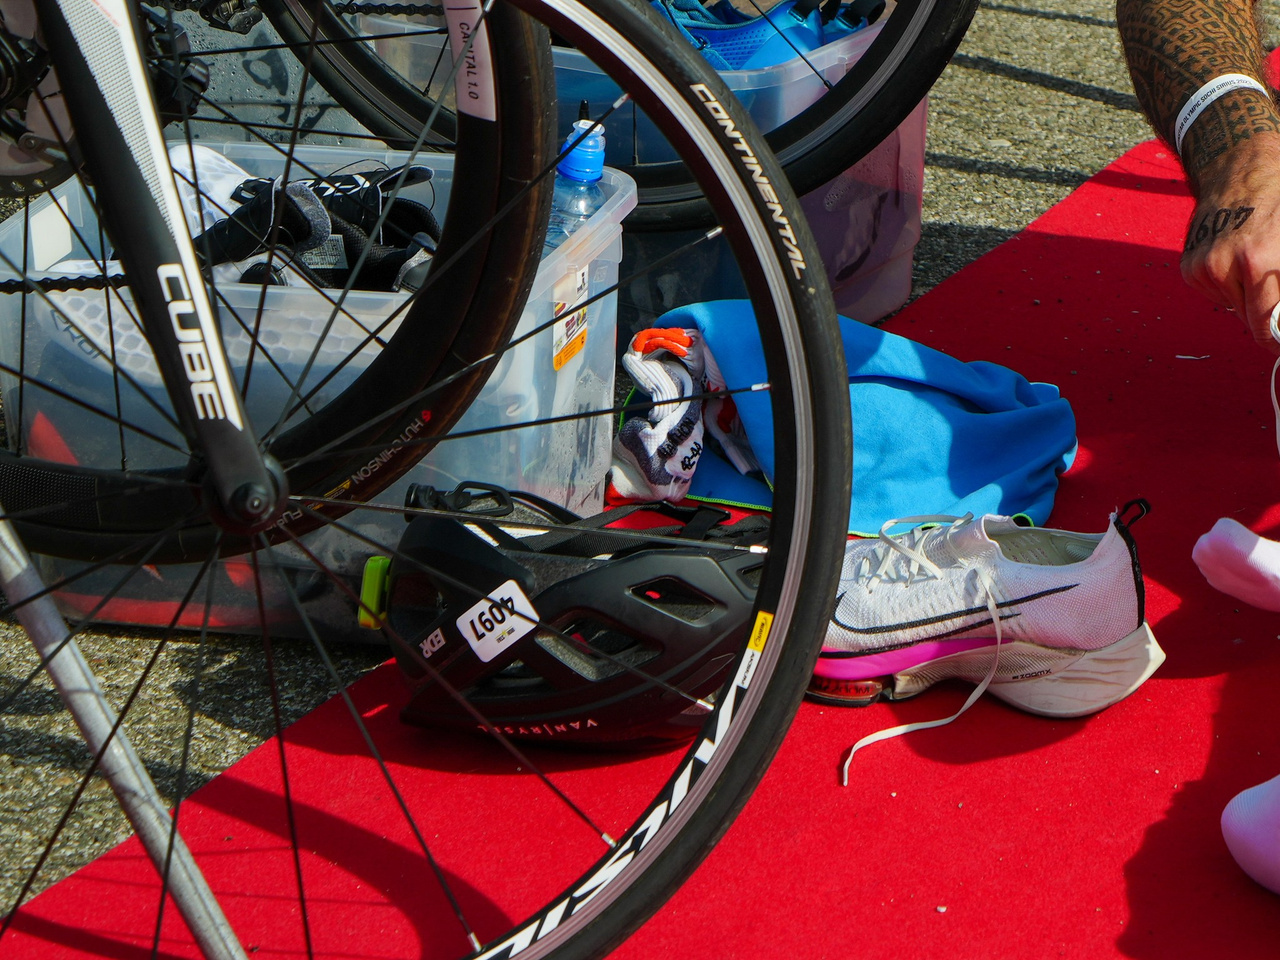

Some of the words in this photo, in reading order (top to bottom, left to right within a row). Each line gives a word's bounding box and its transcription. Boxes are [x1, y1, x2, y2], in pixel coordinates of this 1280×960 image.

[458, 21, 477, 78] CAITAL
[467, 81, 479, 100] 1.0
[1183, 100, 1202, 124] OLYMPIC
[1200, 88, 1217, 103] SOCHI
[690, 83, 807, 280] CONTINENTAL
[156, 262, 226, 420] CUBE
[351, 417, 424, 485] HUTCHINSON
[418, 626, 446, 659] EDR
[469, 595, 516, 642] 4097
